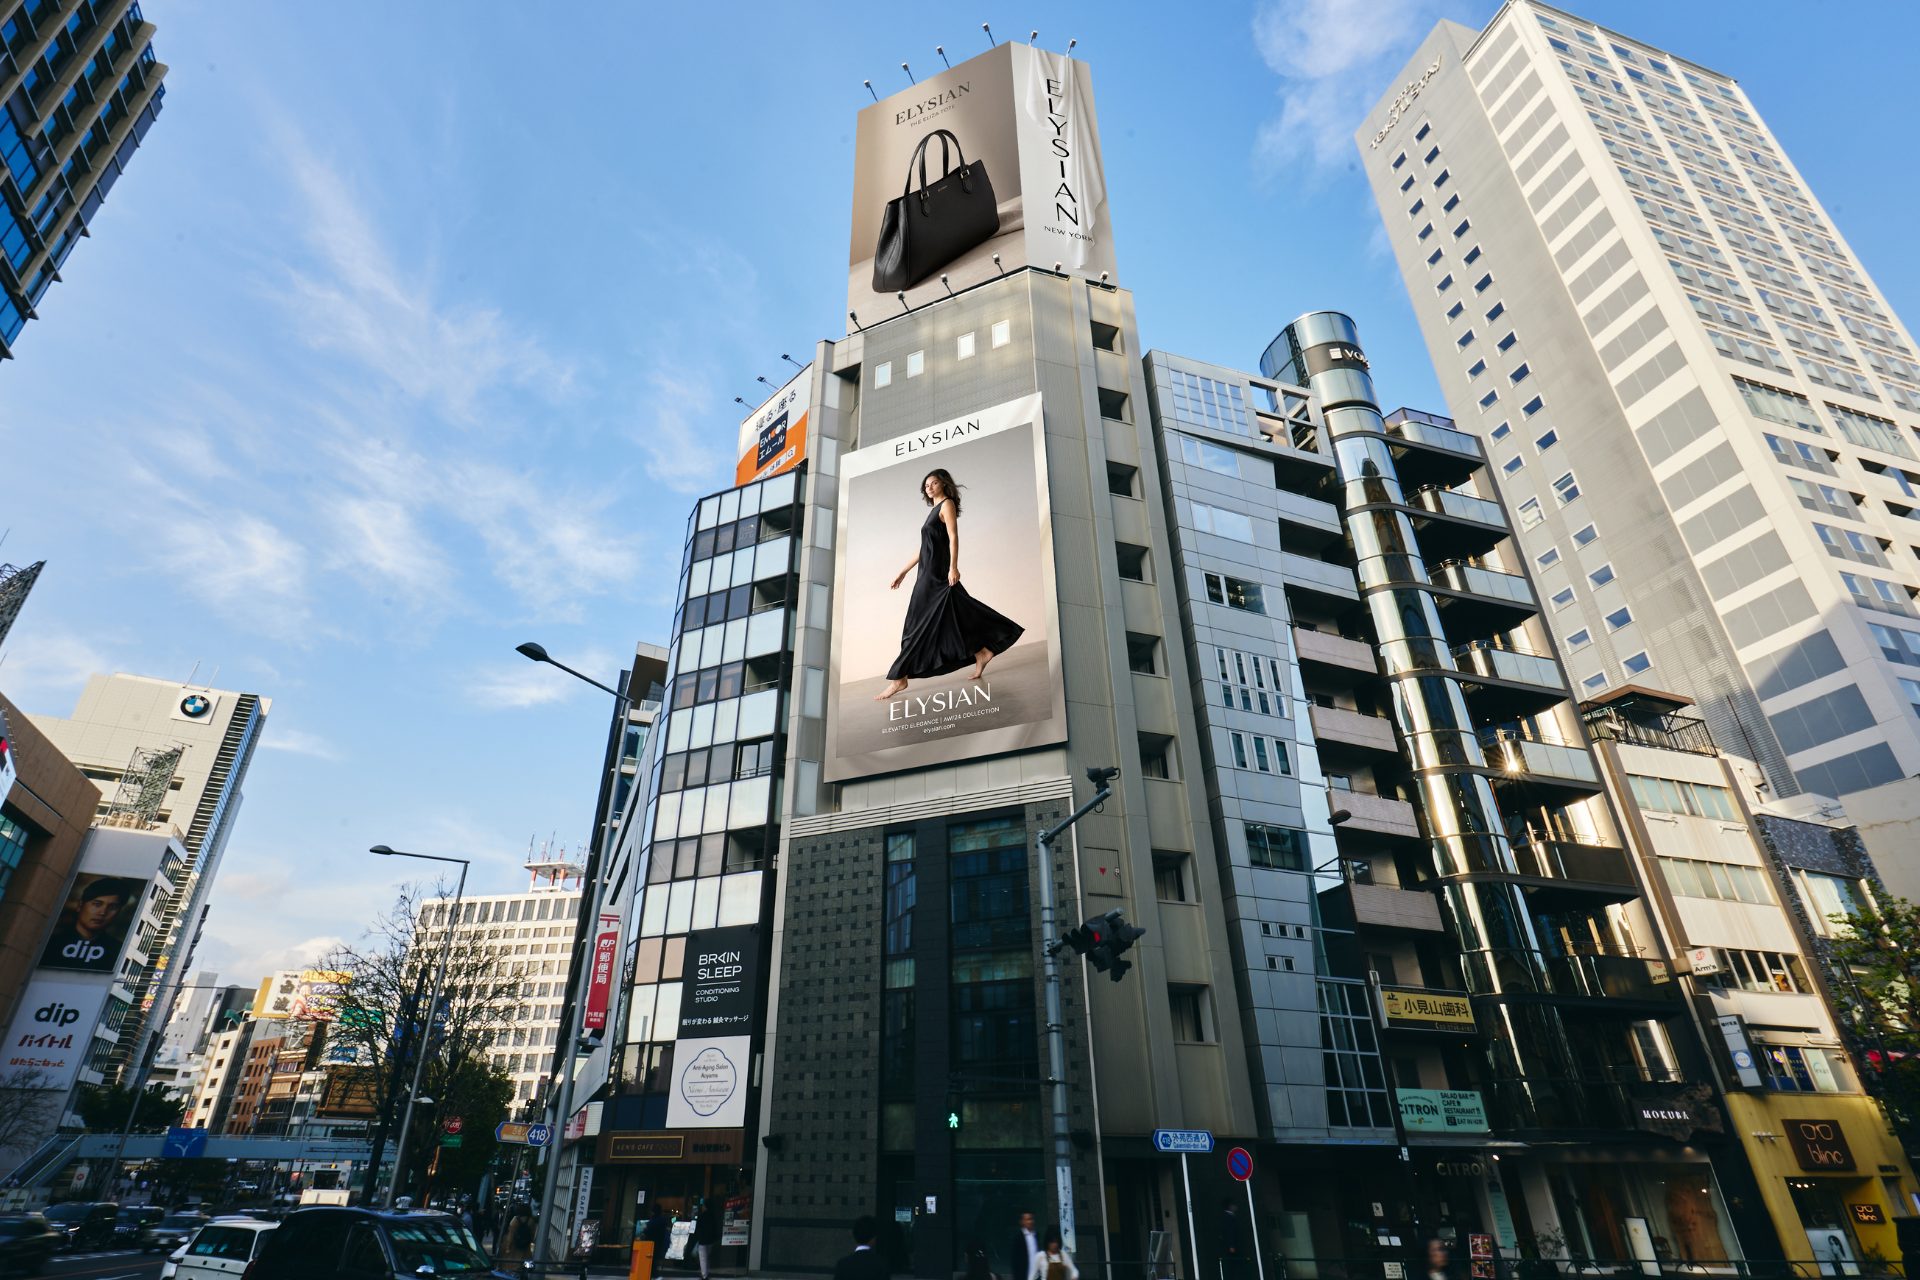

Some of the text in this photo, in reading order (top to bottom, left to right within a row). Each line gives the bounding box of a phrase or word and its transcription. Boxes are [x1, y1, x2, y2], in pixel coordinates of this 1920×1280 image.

[895, 81, 970, 125] ELYSIAN
[1046, 78, 1079, 226] ELYSIAN
[1044, 225, 1093, 242] NEW YORK
[895, 419, 980, 456] ELYSIAN
[889, 682, 991, 721] ELYSIAN
[962, 706, 1000, 719] COLLECTION
[923, 723, 956, 734] elysian.com
[62, 940, 104, 962] dip
[698, 951, 741, 966] BRAIN
[595, 952, 611, 985] 郵便局
[697, 965, 743, 980] SLEEP
[1694, 964, 1717, 973] Arm's
[695, 986, 740, 996] CONDITIONING
[695, 995, 719, 1004] STUDIO
[34, 1003, 80, 1027] dip
[1404, 998, 1469, 1017] 小見山歯科
[18, 1033, 73, 1049] バイトル
[1642, 1109, 1690, 1120] MOKUBA
[529, 1129, 547, 1141] 418
[1806, 1143, 1845, 1165] blinc
[578, 1195, 587, 1216] CAFE
